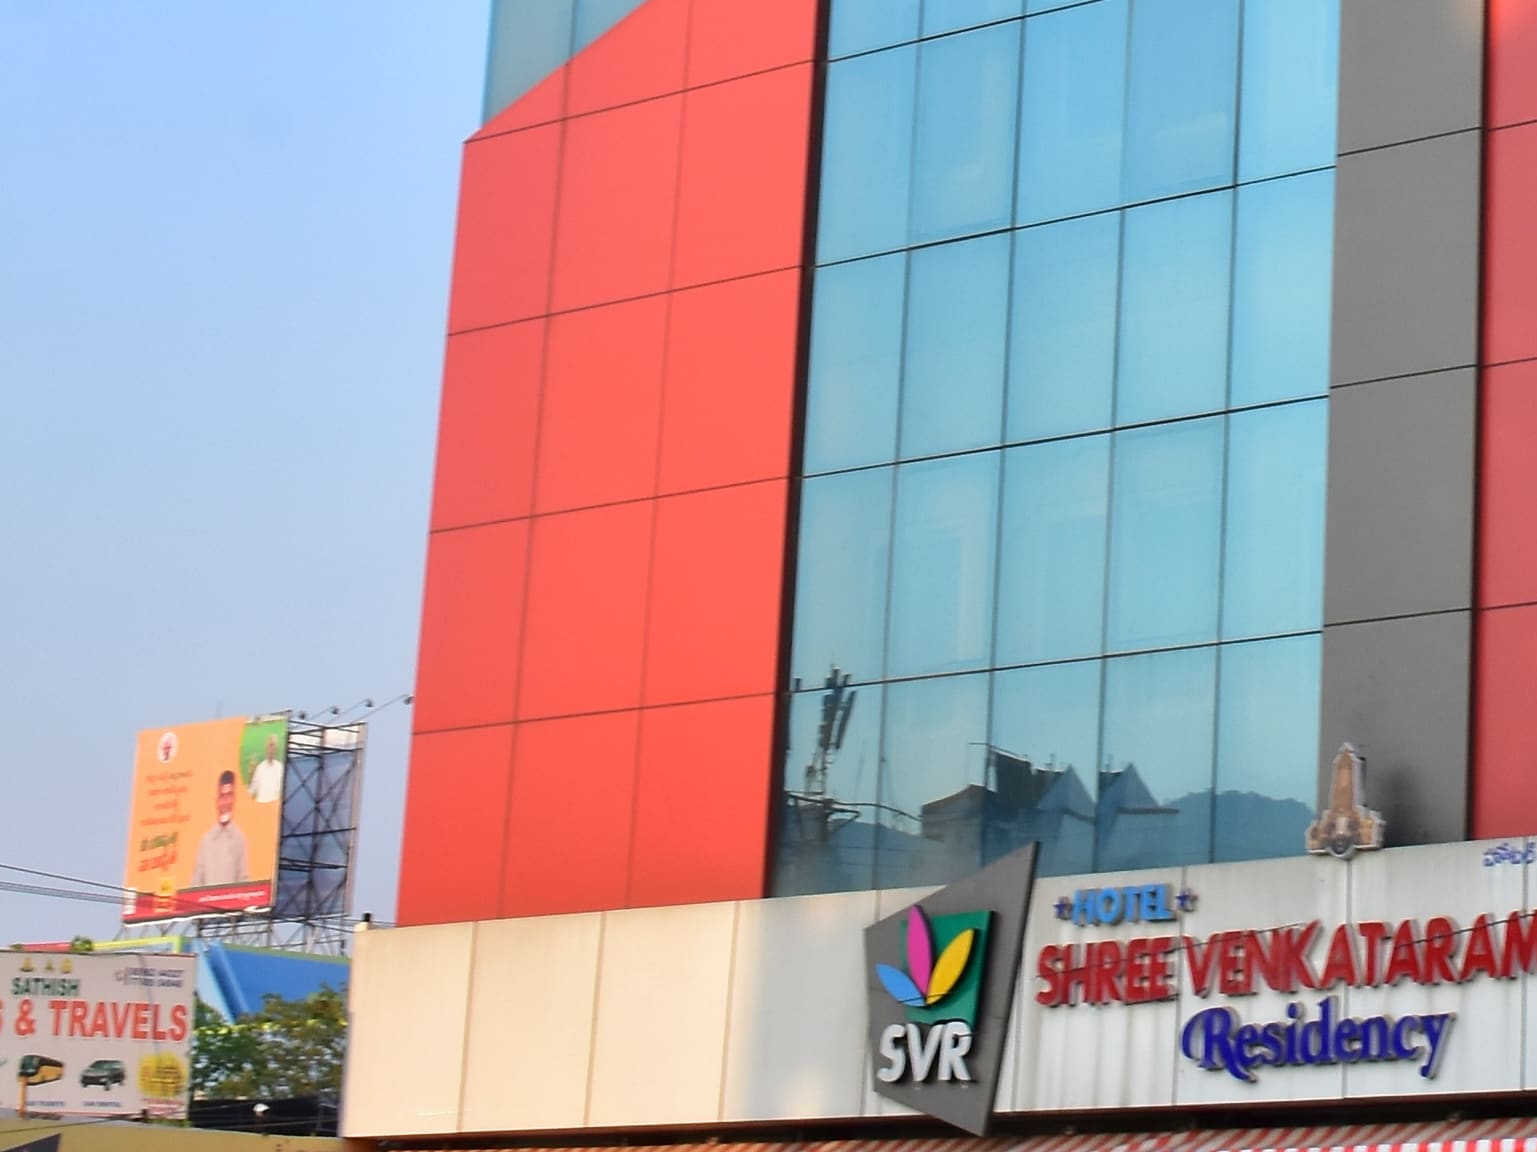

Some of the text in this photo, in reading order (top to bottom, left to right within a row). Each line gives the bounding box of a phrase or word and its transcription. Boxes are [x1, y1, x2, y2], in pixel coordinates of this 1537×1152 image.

[1071, 882, 1176, 926] HOTEL
[11, 977, 79, 996] SATHISH
[1035, 936, 1181, 1008] SHREE
[14, 998, 36, 1036] &
[48, 999, 187, 1042] TRAVELS
[1181, 996, 1457, 1083] Residency
[877, 1020, 975, 1084] SVR
